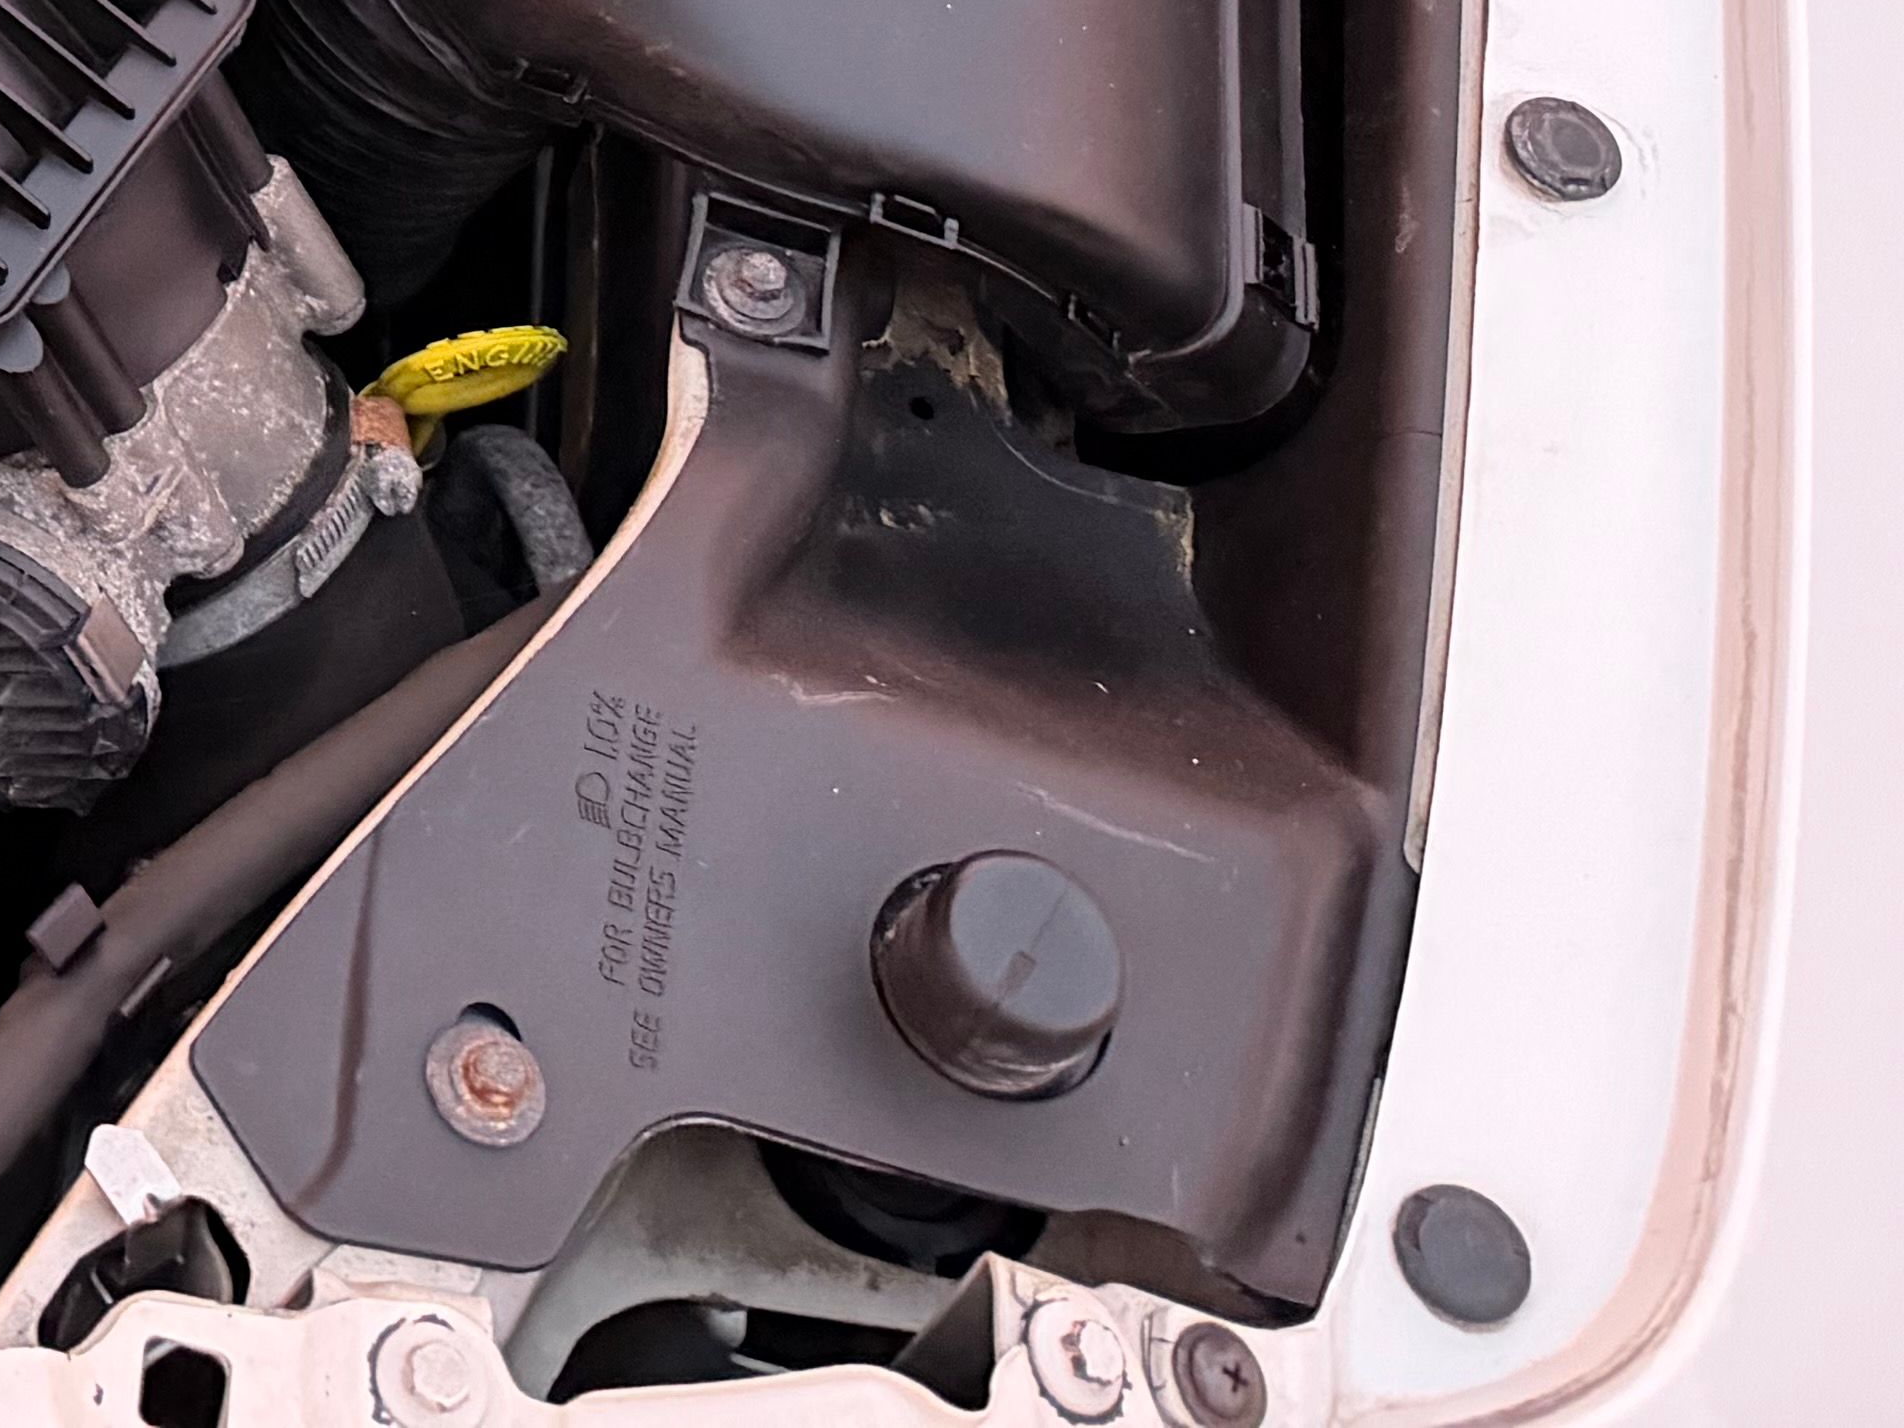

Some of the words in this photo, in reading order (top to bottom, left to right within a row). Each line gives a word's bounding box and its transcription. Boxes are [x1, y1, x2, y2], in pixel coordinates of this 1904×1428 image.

[655, 725, 697, 859] MANUAL
[598, 923, 633, 985] FOR
[639, 866, 676, 997] OWNERS
[629, 1008, 662, 1072] SEE
